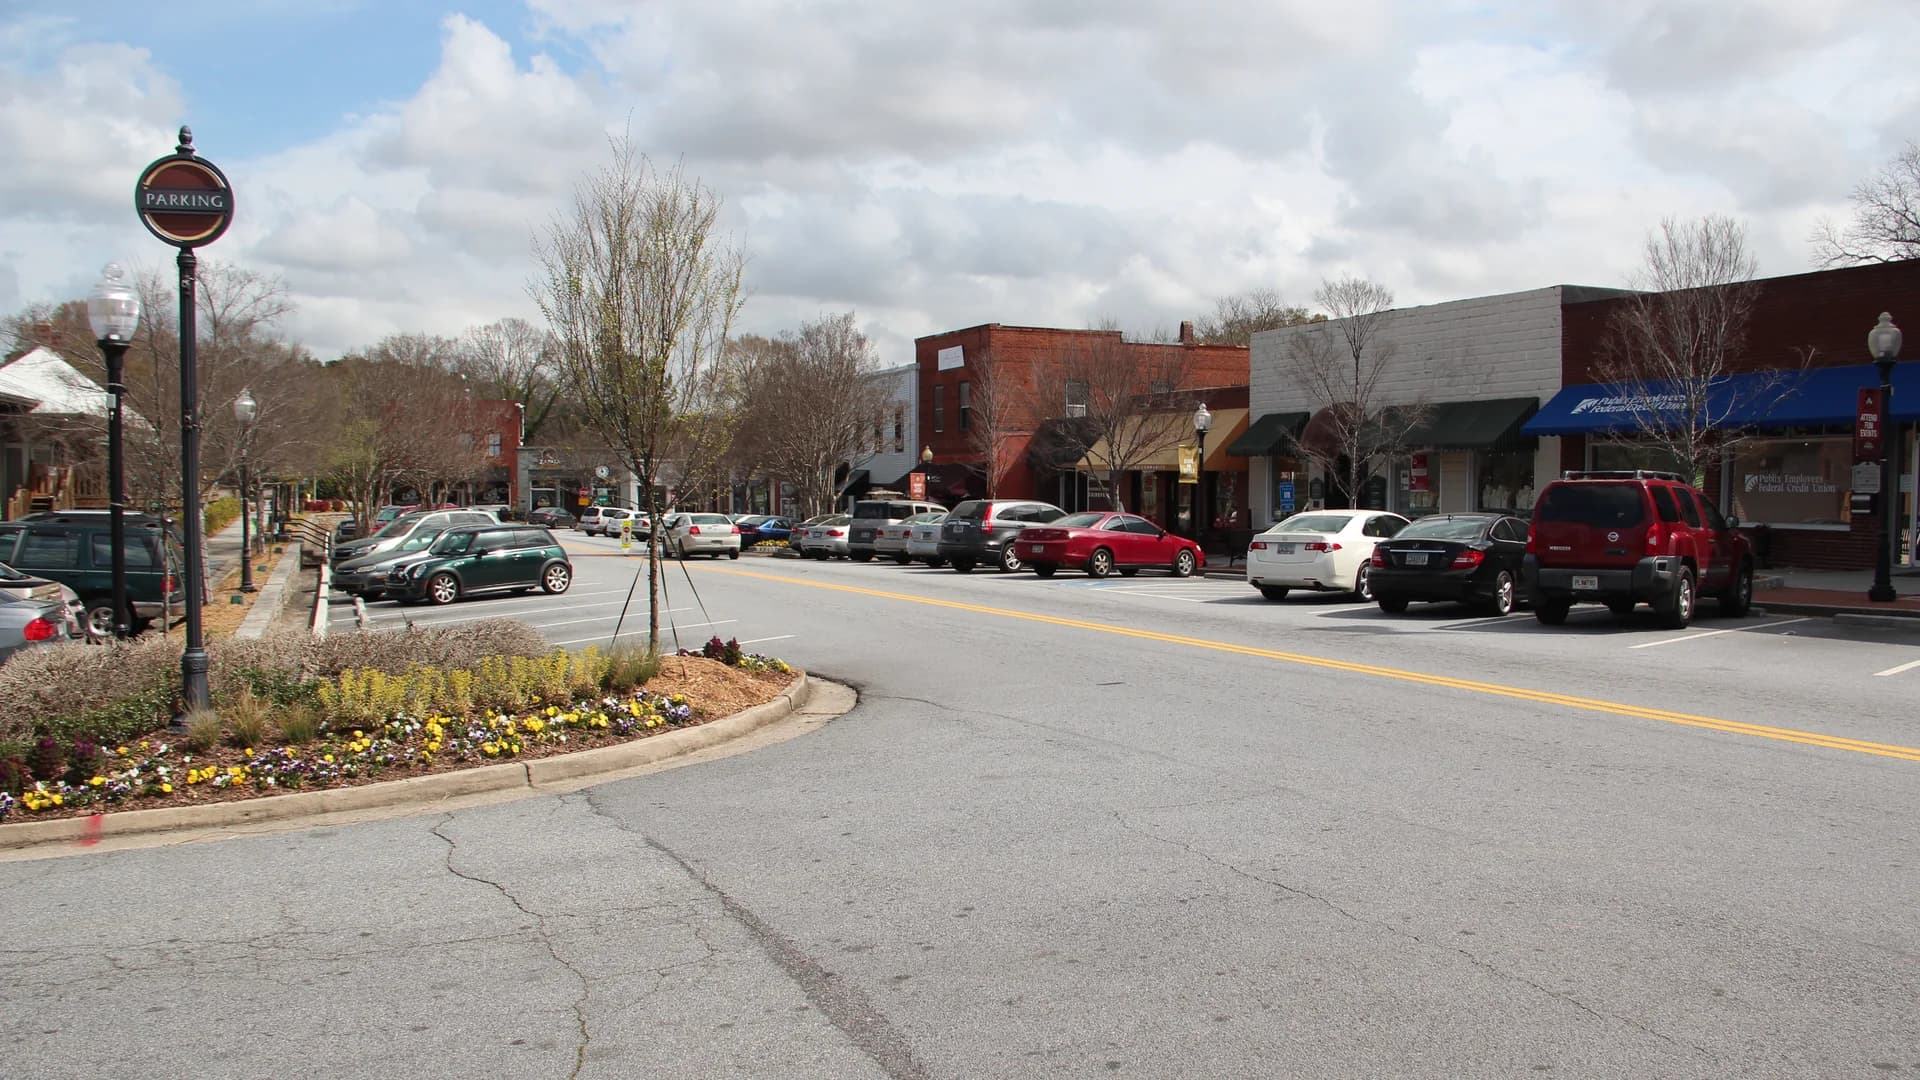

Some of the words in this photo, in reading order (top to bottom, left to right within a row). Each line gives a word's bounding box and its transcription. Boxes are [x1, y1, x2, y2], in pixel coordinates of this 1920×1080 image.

[145, 193, 223, 208] PARKING
[1590, 404, 1627, 413] Federal
[1860, 413, 1878, 422] ATTEND
[1860, 429, 1878, 437] EVENTS
[1784, 473, 1824, 484] Employees
[1758, 483, 1784, 492] Federal
[1786, 483, 1809, 492] Credit
[1812, 484, 1836, 493] Union
